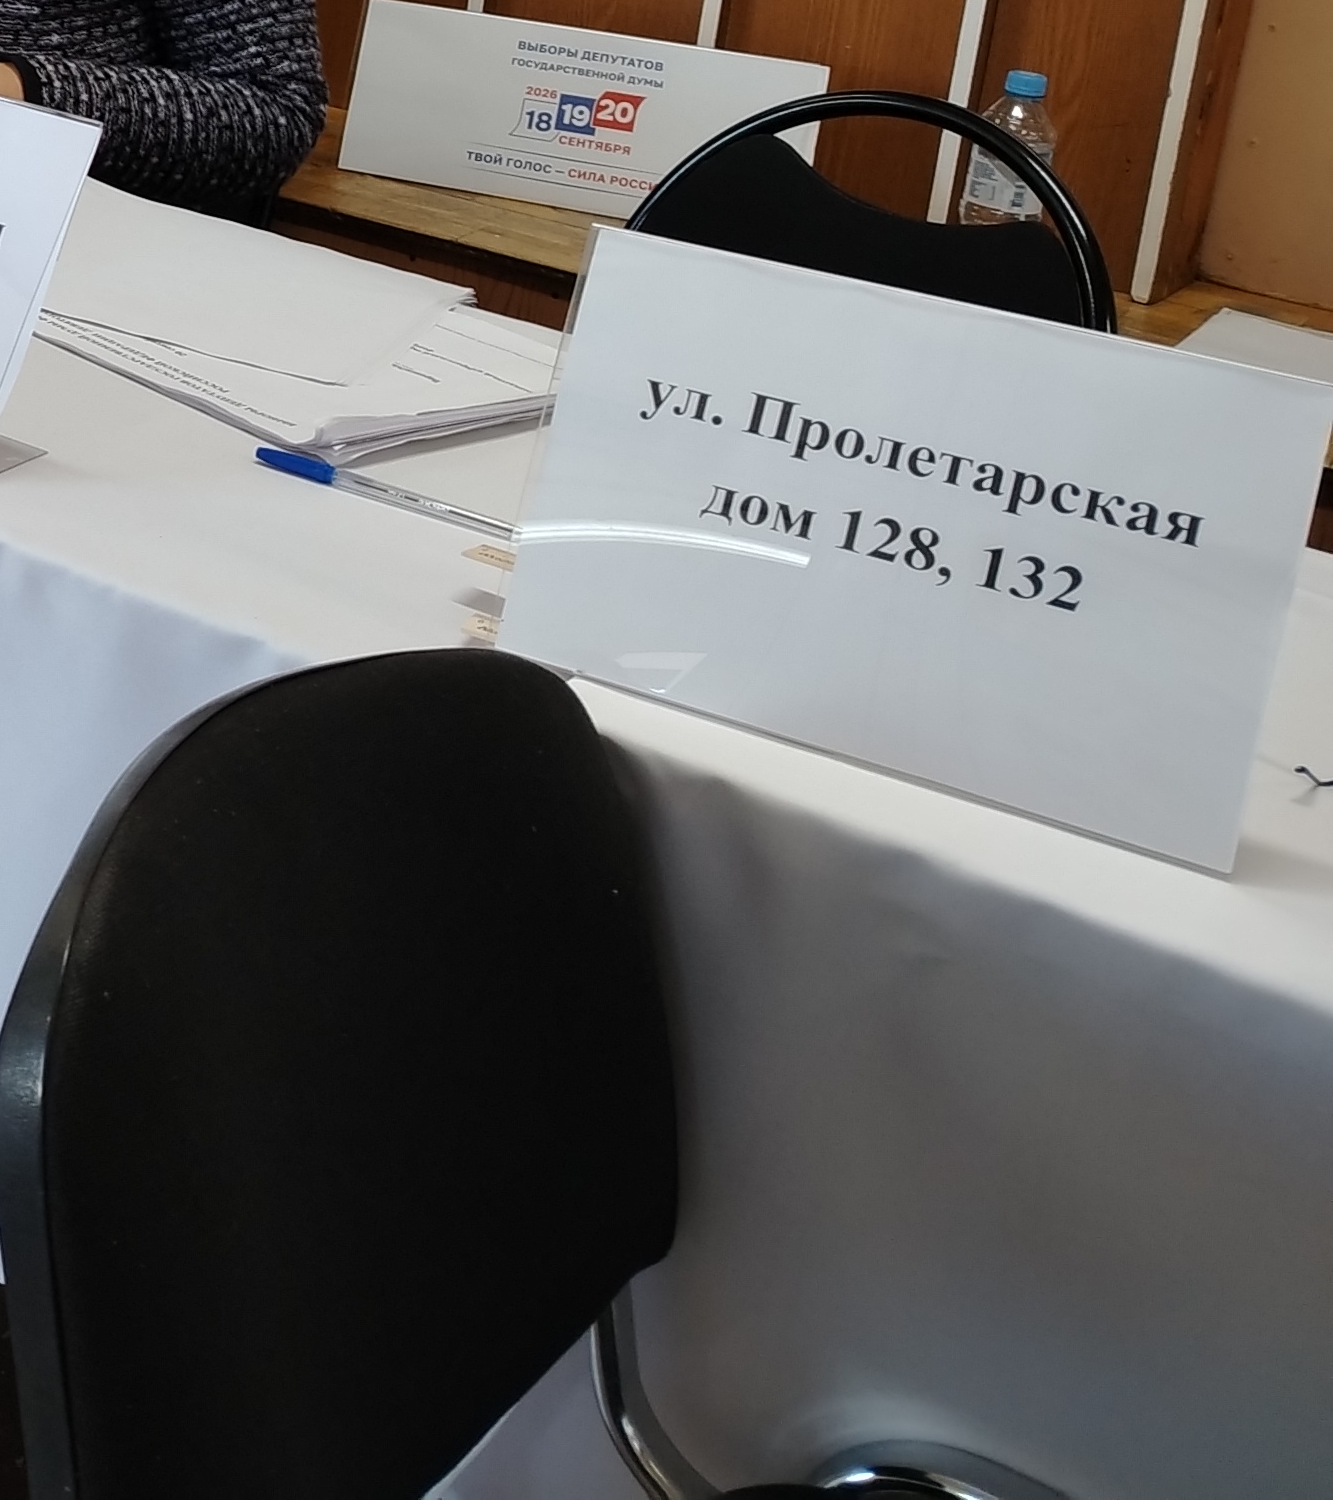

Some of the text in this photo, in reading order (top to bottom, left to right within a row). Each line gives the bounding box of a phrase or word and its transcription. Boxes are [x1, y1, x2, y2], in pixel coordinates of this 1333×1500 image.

[511, 56, 665, 89] ГОСУДАРСТВЕННОЙ ДУМЫ
[517, 40, 665, 72] ВЫБОРЫ ДЕПУТАТОВ
[525, 85, 559, 100] 2026
[524, 98, 635, 134] 18 19 20
[558, 134, 631, 157] СЕНТЯБРЯ
[466, 148, 504, 167] ТВОЙ
[505, 156, 553, 176] ГОЛОС
[567, 167, 606, 185] СИЛА
[609, 174, 659, 193] РОССИ
[637, 376, 1206, 550] ул. Пролетарская
[699, 483, 1086, 614] дом 128, 132
